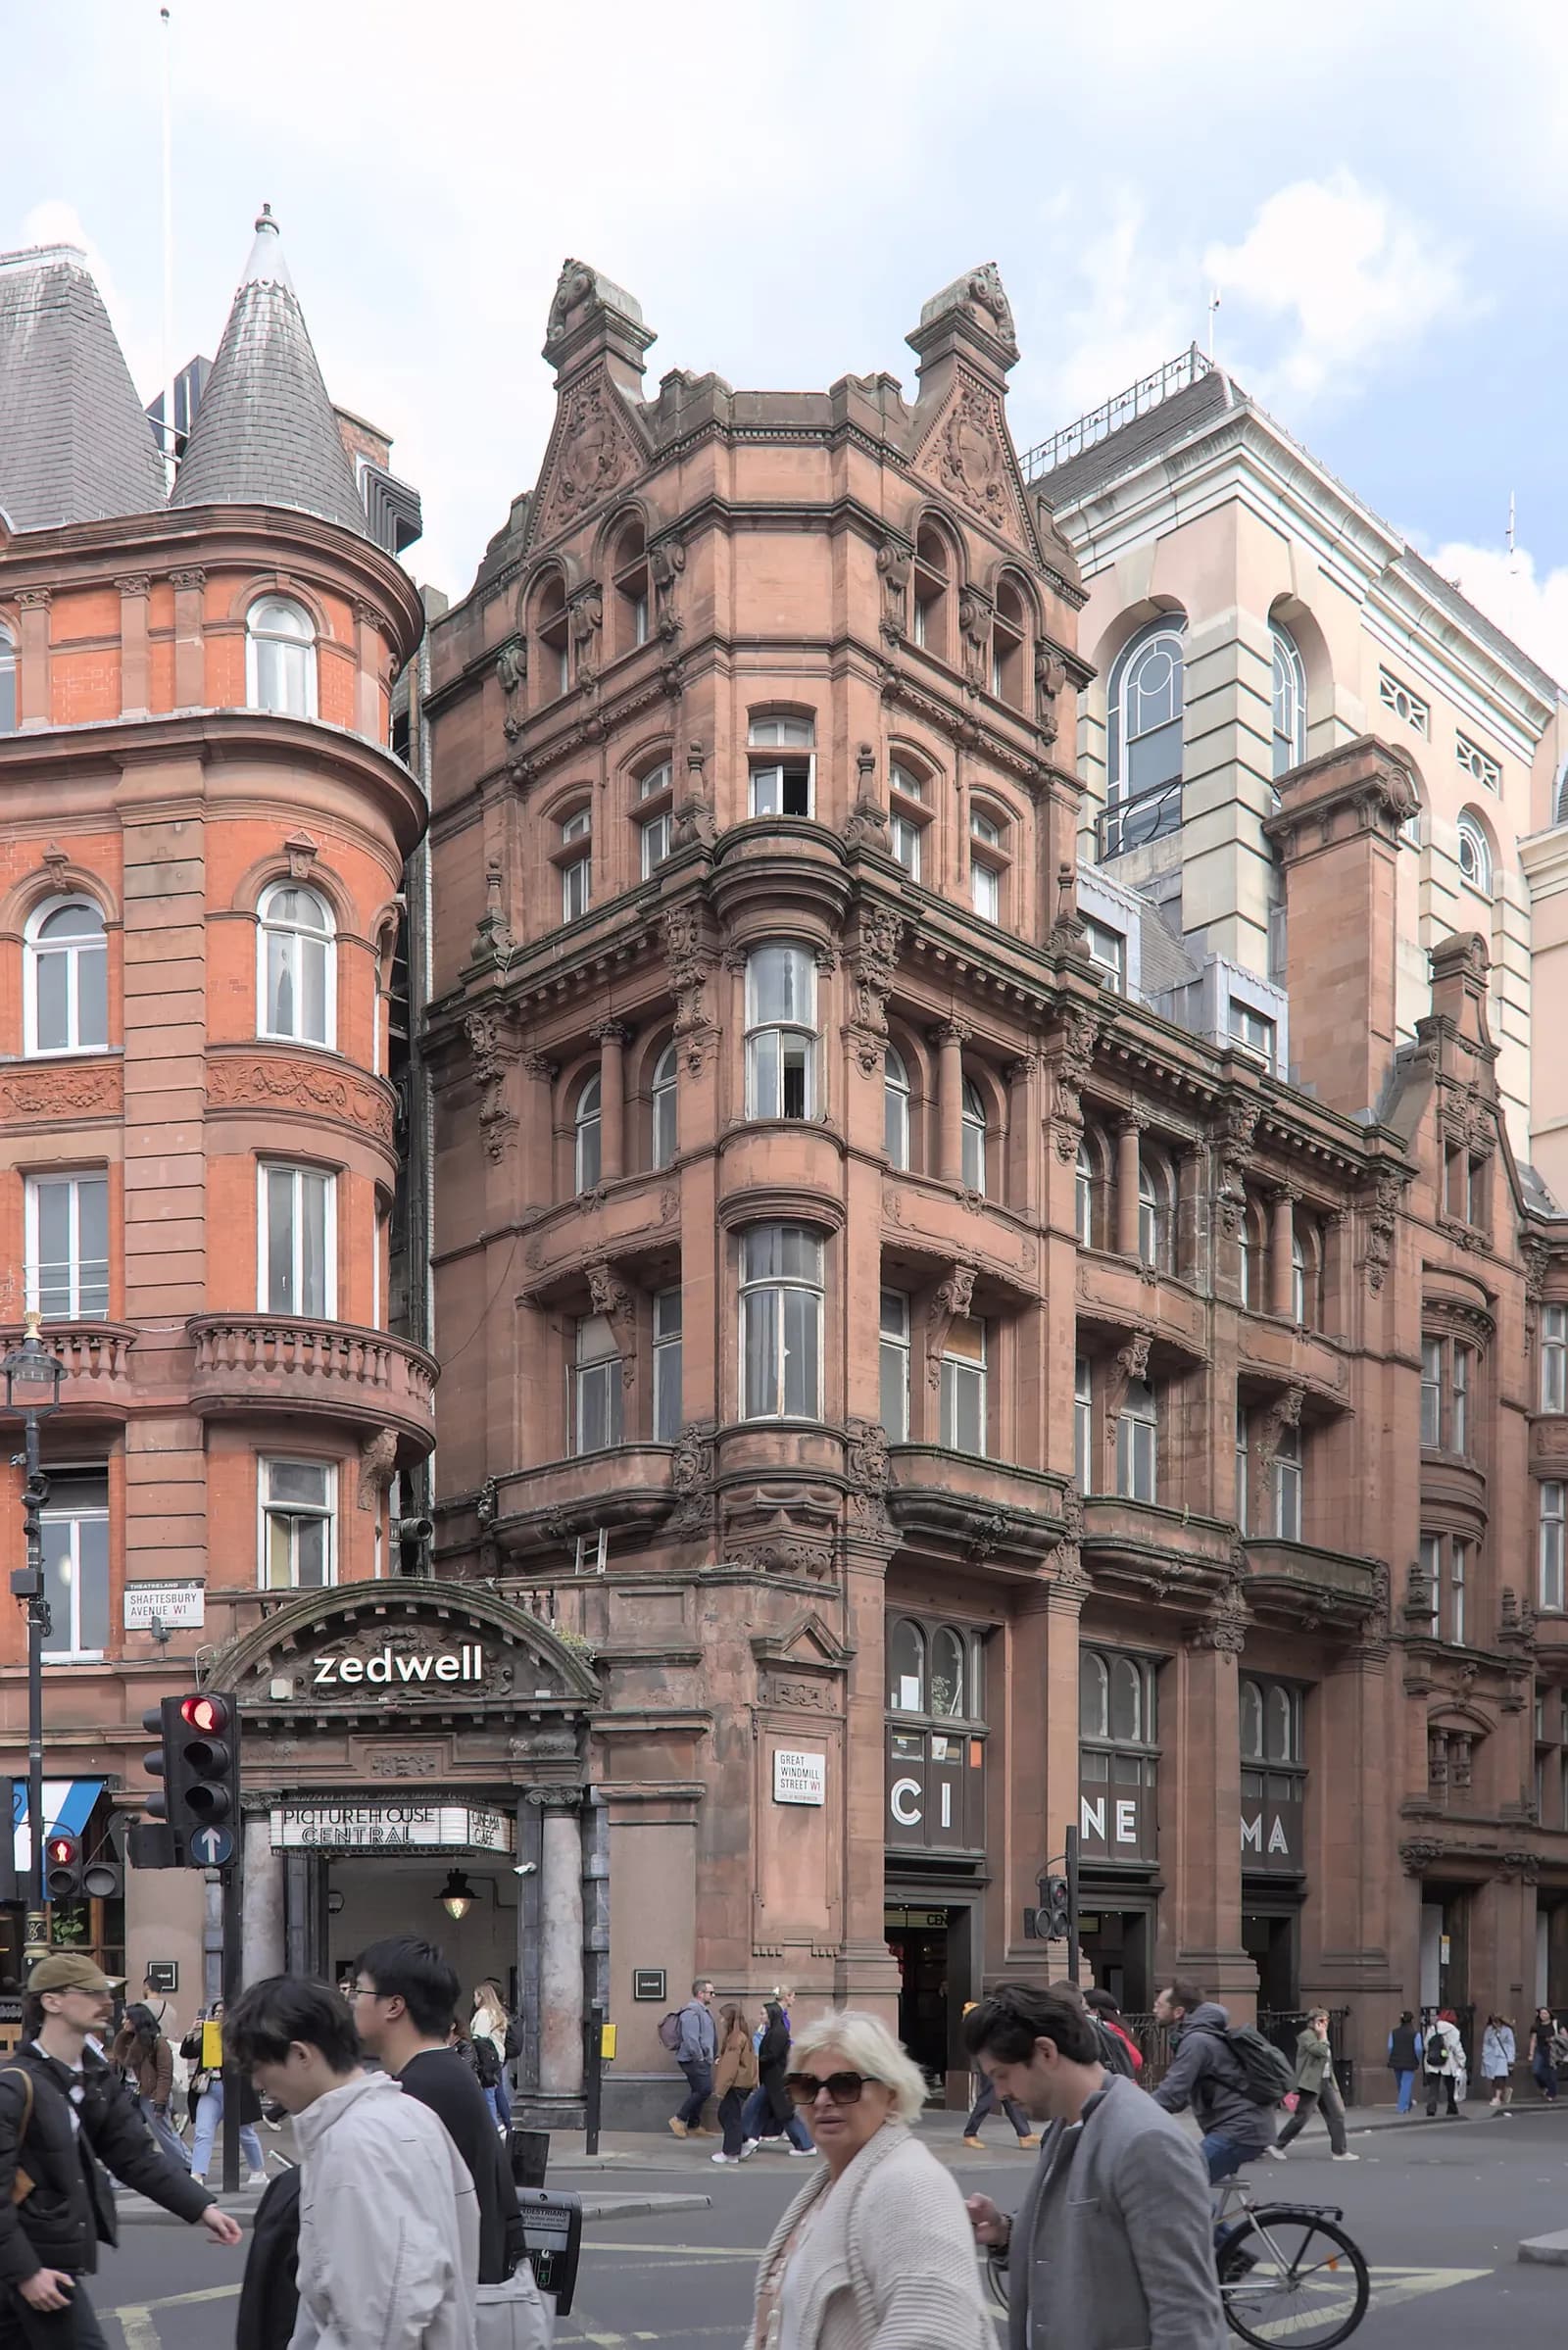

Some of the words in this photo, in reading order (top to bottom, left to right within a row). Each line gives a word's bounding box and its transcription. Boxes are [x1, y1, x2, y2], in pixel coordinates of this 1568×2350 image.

[129, 1593, 197, 1605] SHAFTESBURY
[130, 1605, 168, 1616] AVENUE
[173, 1605, 187, 1614] W1
[313, 1644, 482, 1684] zedwell
[780, 1754, 805, 1766] GREAT
[780, 1767, 819, 1780] WINDMILL
[780, 1778, 808, 1790] STREET
[809, 1781, 820, 1791] W1
[283, 1807, 435, 1825] PICTUREHOUSE
[302, 1826, 416, 1845] CENTRAL
